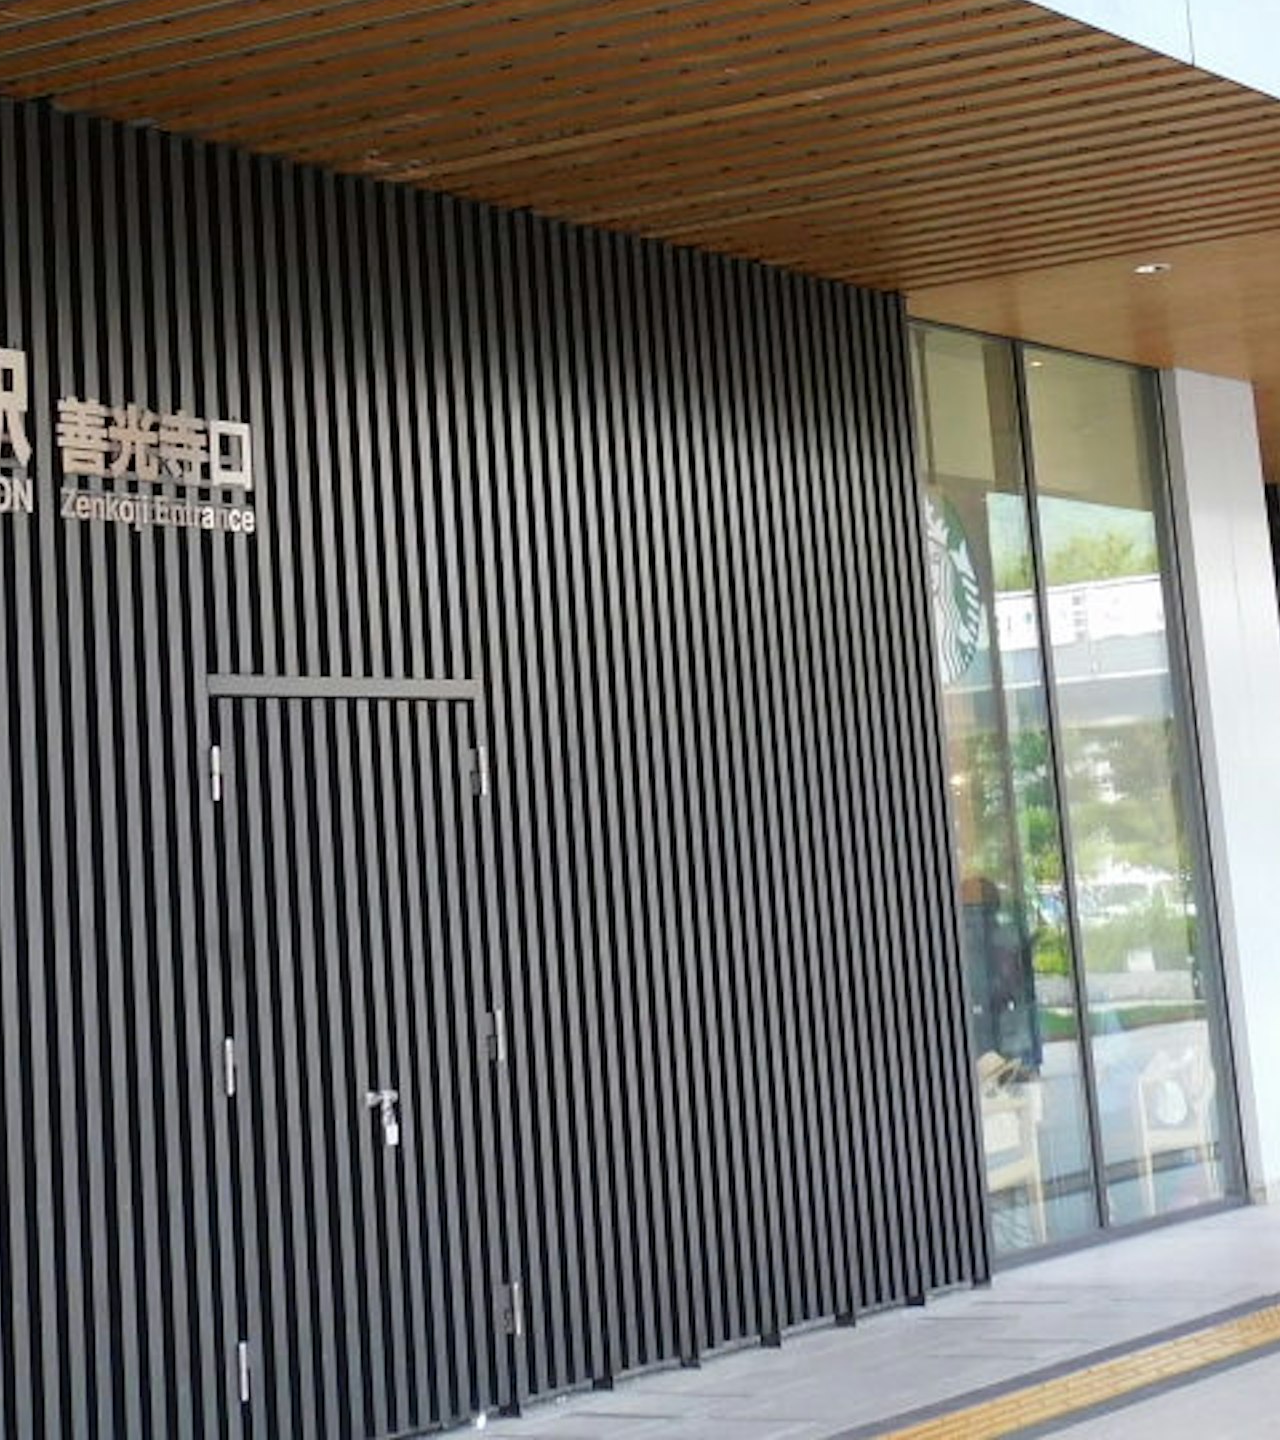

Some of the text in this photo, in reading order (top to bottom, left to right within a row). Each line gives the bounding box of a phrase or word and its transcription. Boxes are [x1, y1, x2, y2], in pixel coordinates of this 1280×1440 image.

[57, 396, 252, 490] 善光寺口
[155, 495, 256, 533] Entrance
